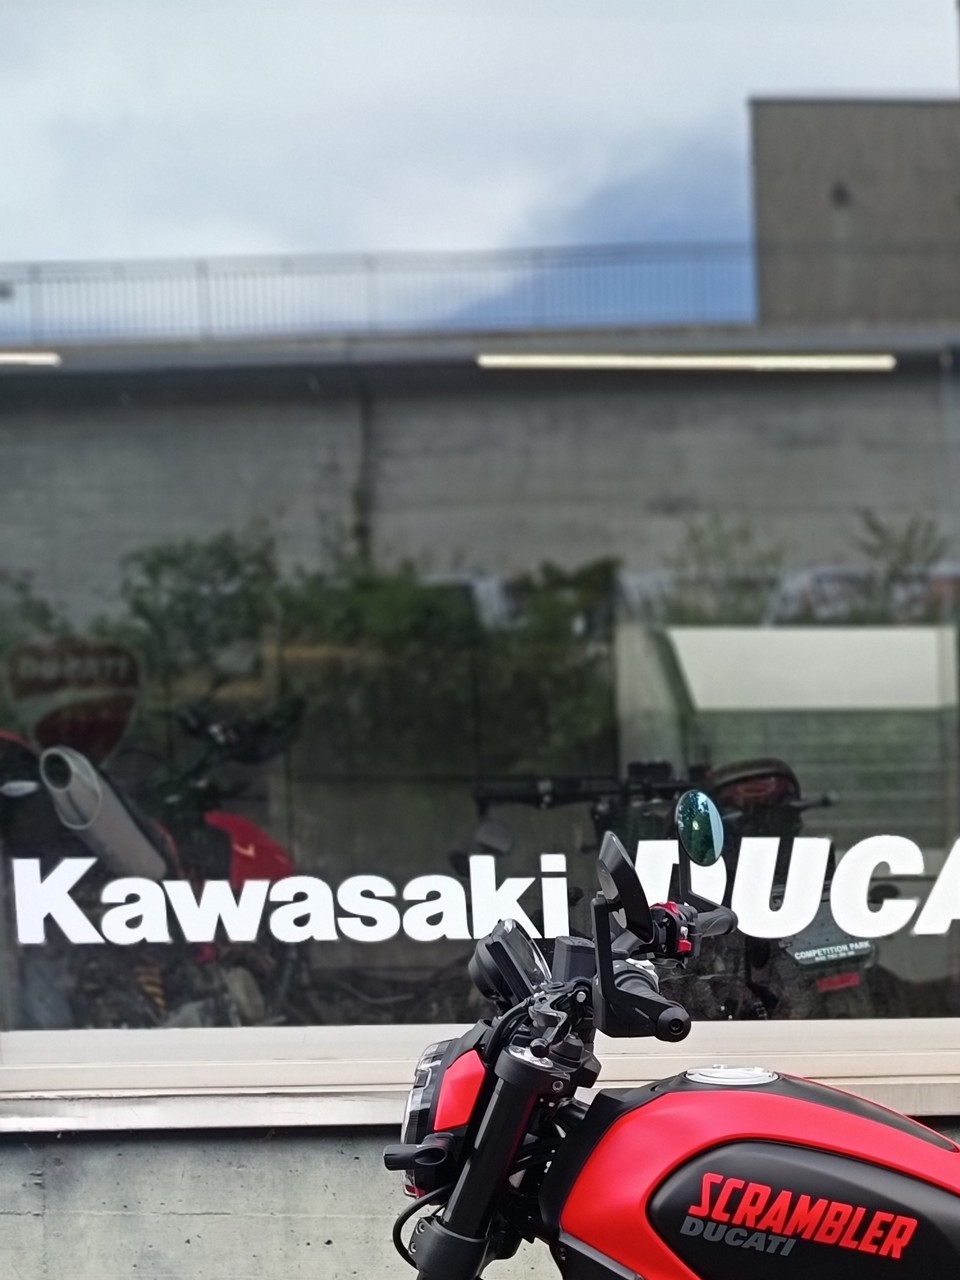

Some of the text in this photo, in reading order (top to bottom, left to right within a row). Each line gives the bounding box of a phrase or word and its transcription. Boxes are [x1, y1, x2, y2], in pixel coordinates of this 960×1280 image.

[12, 853, 570, 944] Kawasaki
[794, 944, 849, 960] COMPETITION
[849, 940, 871, 951] PARK
[680, 1215, 796, 1257] DUCATI
[688, 1172, 918, 1259] SCRAMBLER
